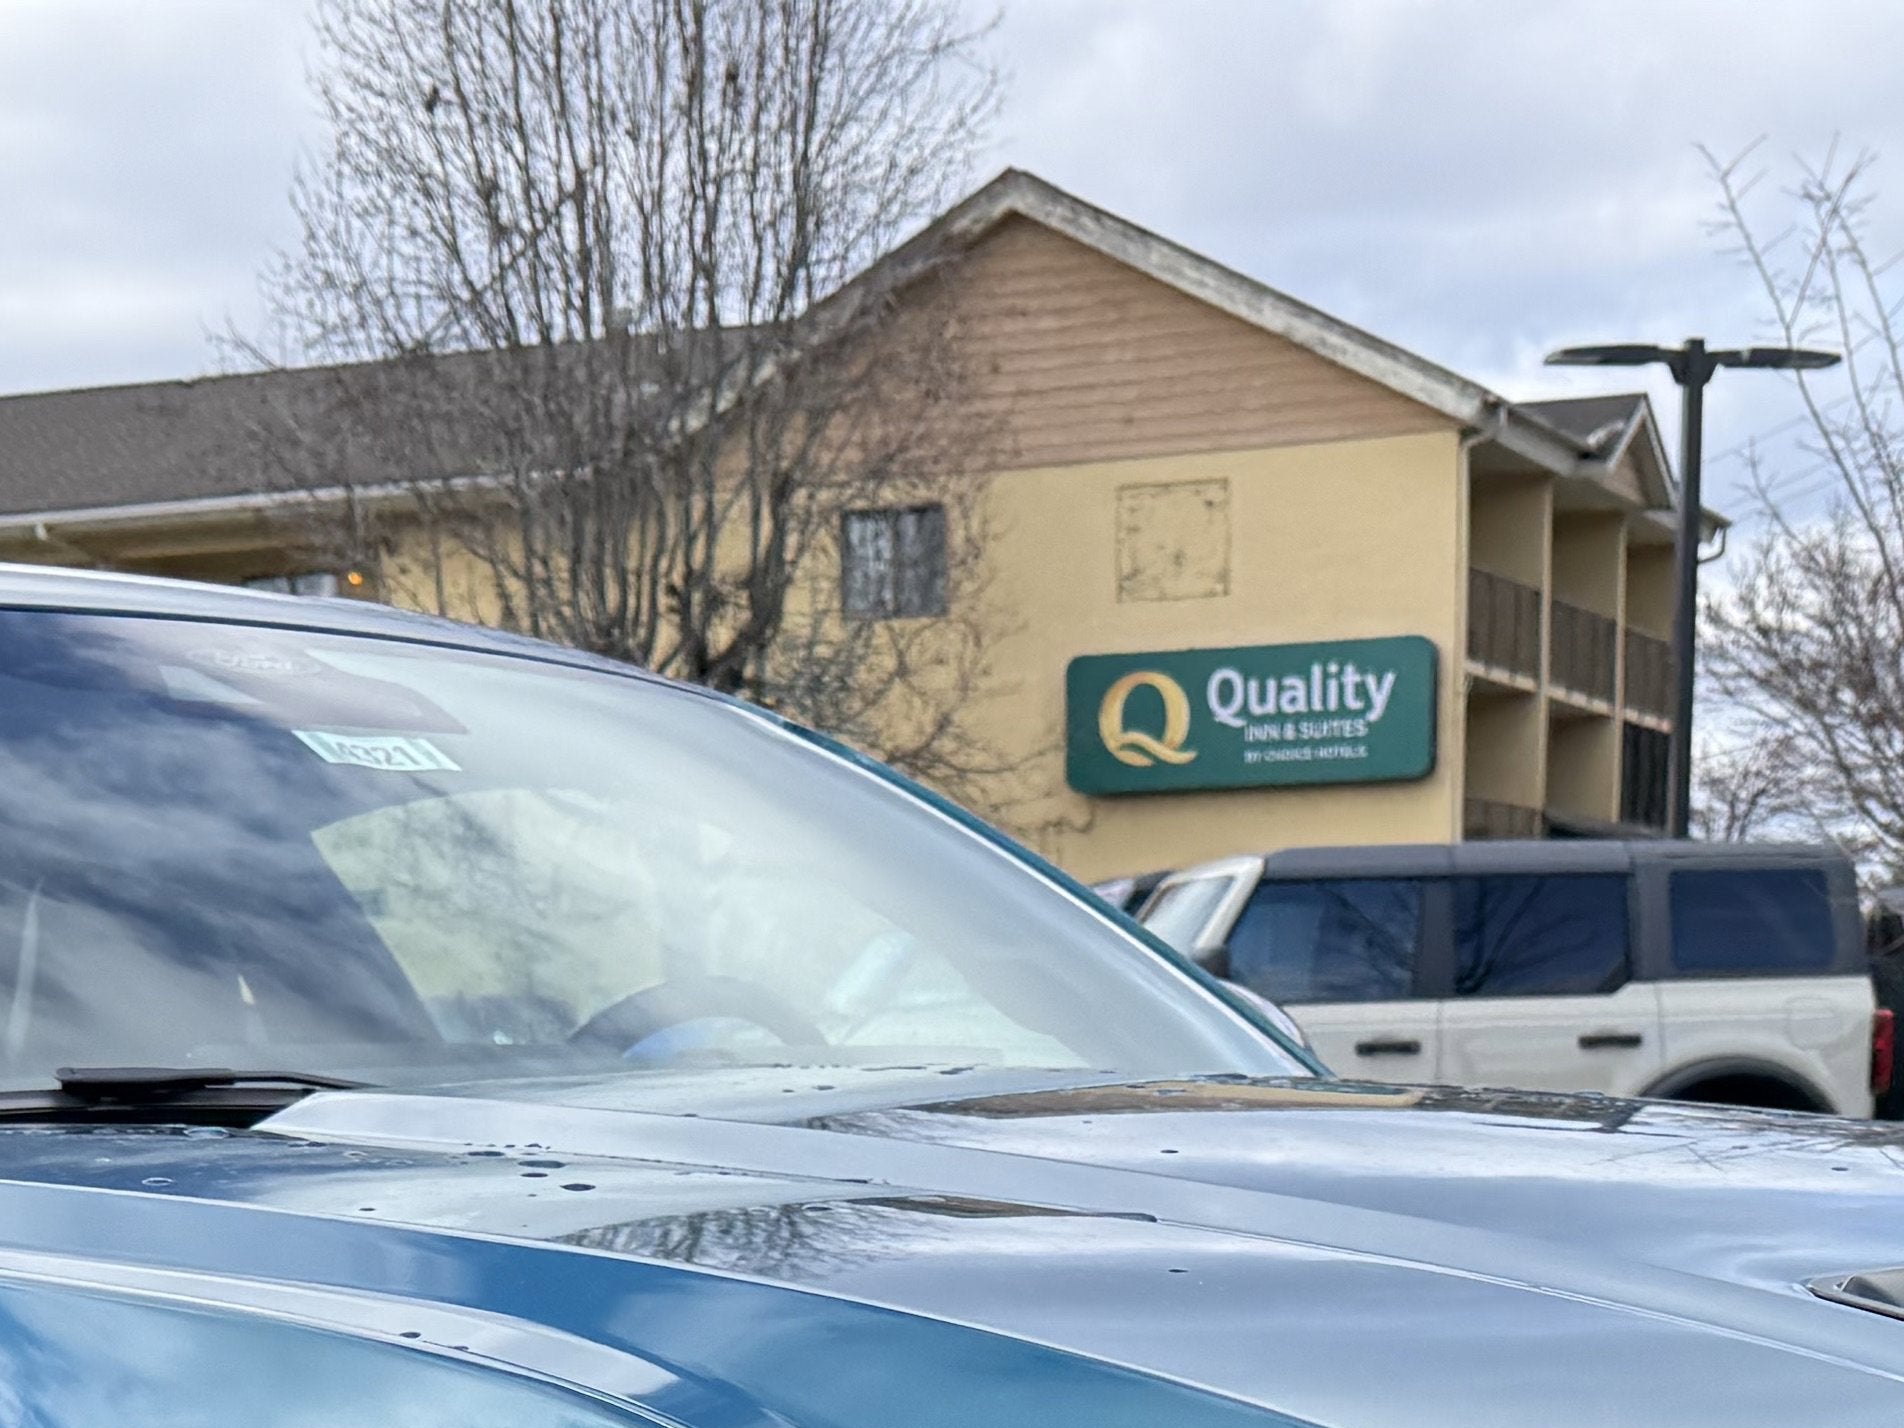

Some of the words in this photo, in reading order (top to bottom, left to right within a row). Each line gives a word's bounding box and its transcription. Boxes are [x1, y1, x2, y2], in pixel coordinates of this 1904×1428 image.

[1099, 671, 1197, 766] Q
[1206, 660, 1397, 728] Quality
[1244, 723, 1280, 742] INN
[1283, 722, 1297, 740] &
[1298, 718, 1368, 740] SUITES
